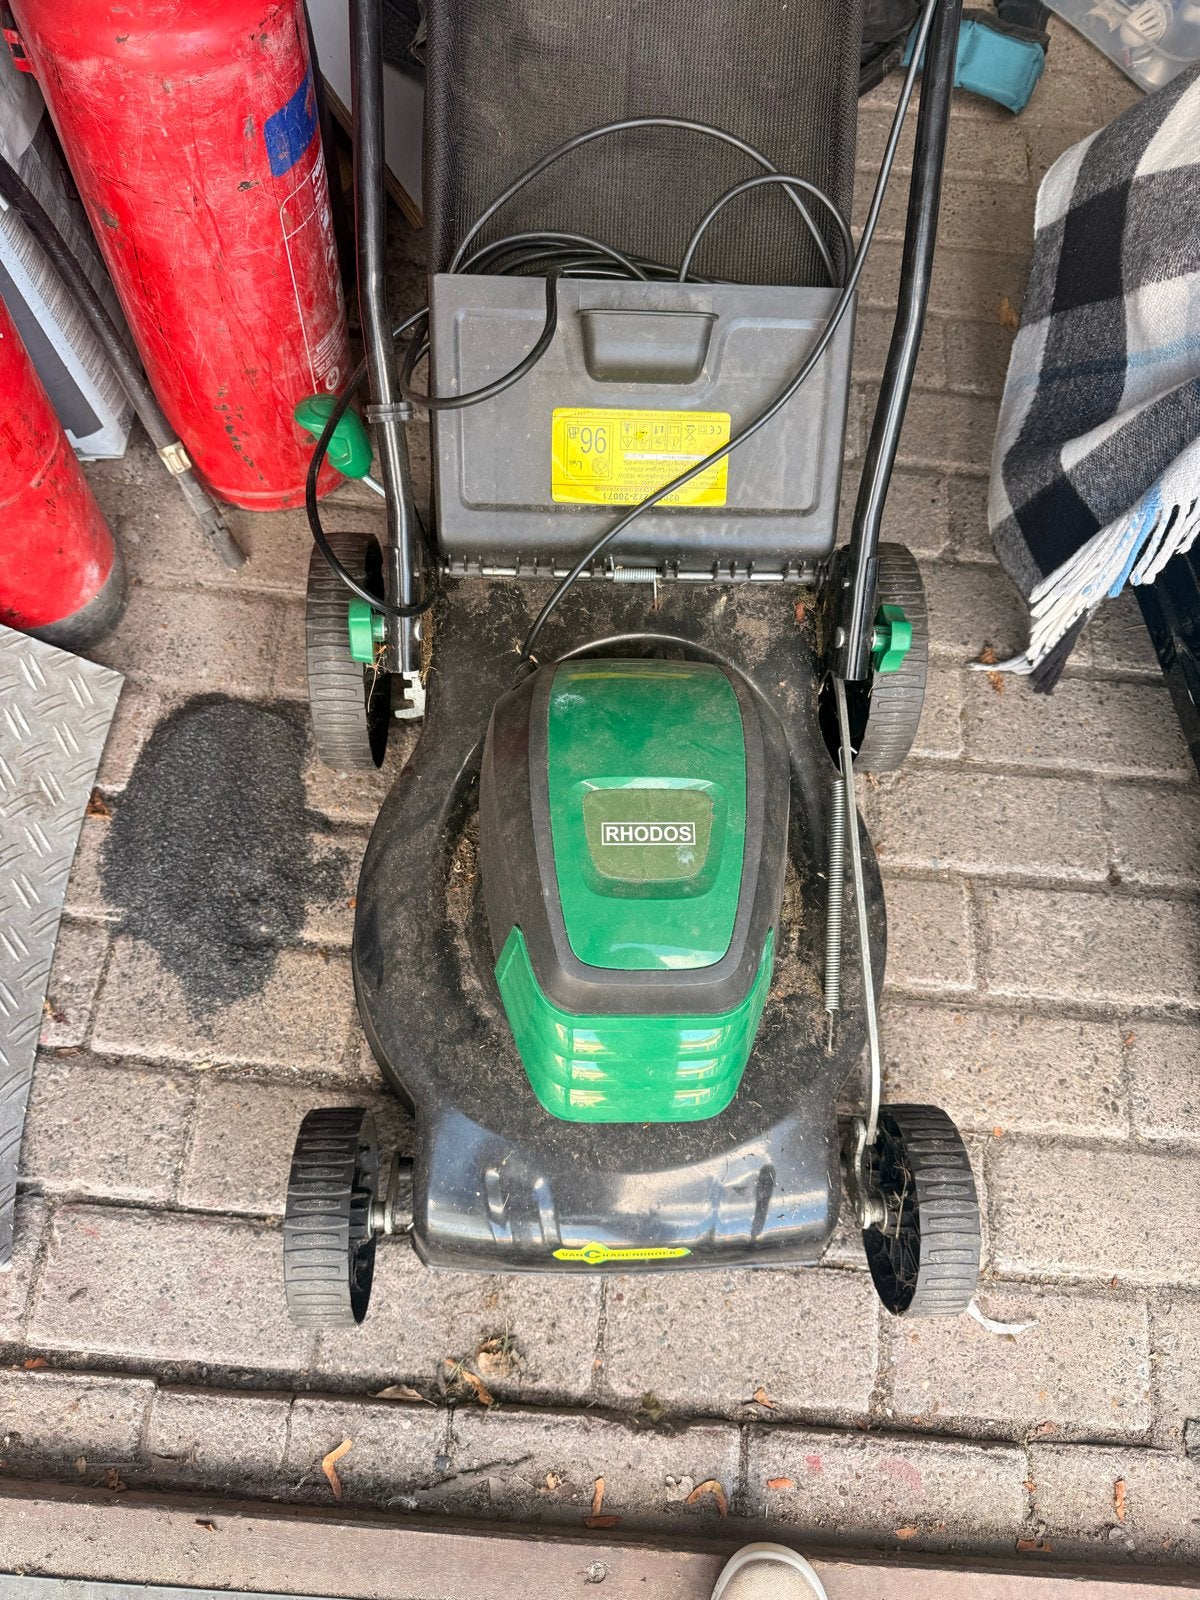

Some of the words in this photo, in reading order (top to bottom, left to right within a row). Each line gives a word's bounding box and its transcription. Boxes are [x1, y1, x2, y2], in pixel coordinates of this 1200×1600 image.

[568, 427, 579, 440] dB
[709, 425, 722, 435] CE
[581, 427, 606, 454] 96
[606, 826, 691, 841] RHODOS
